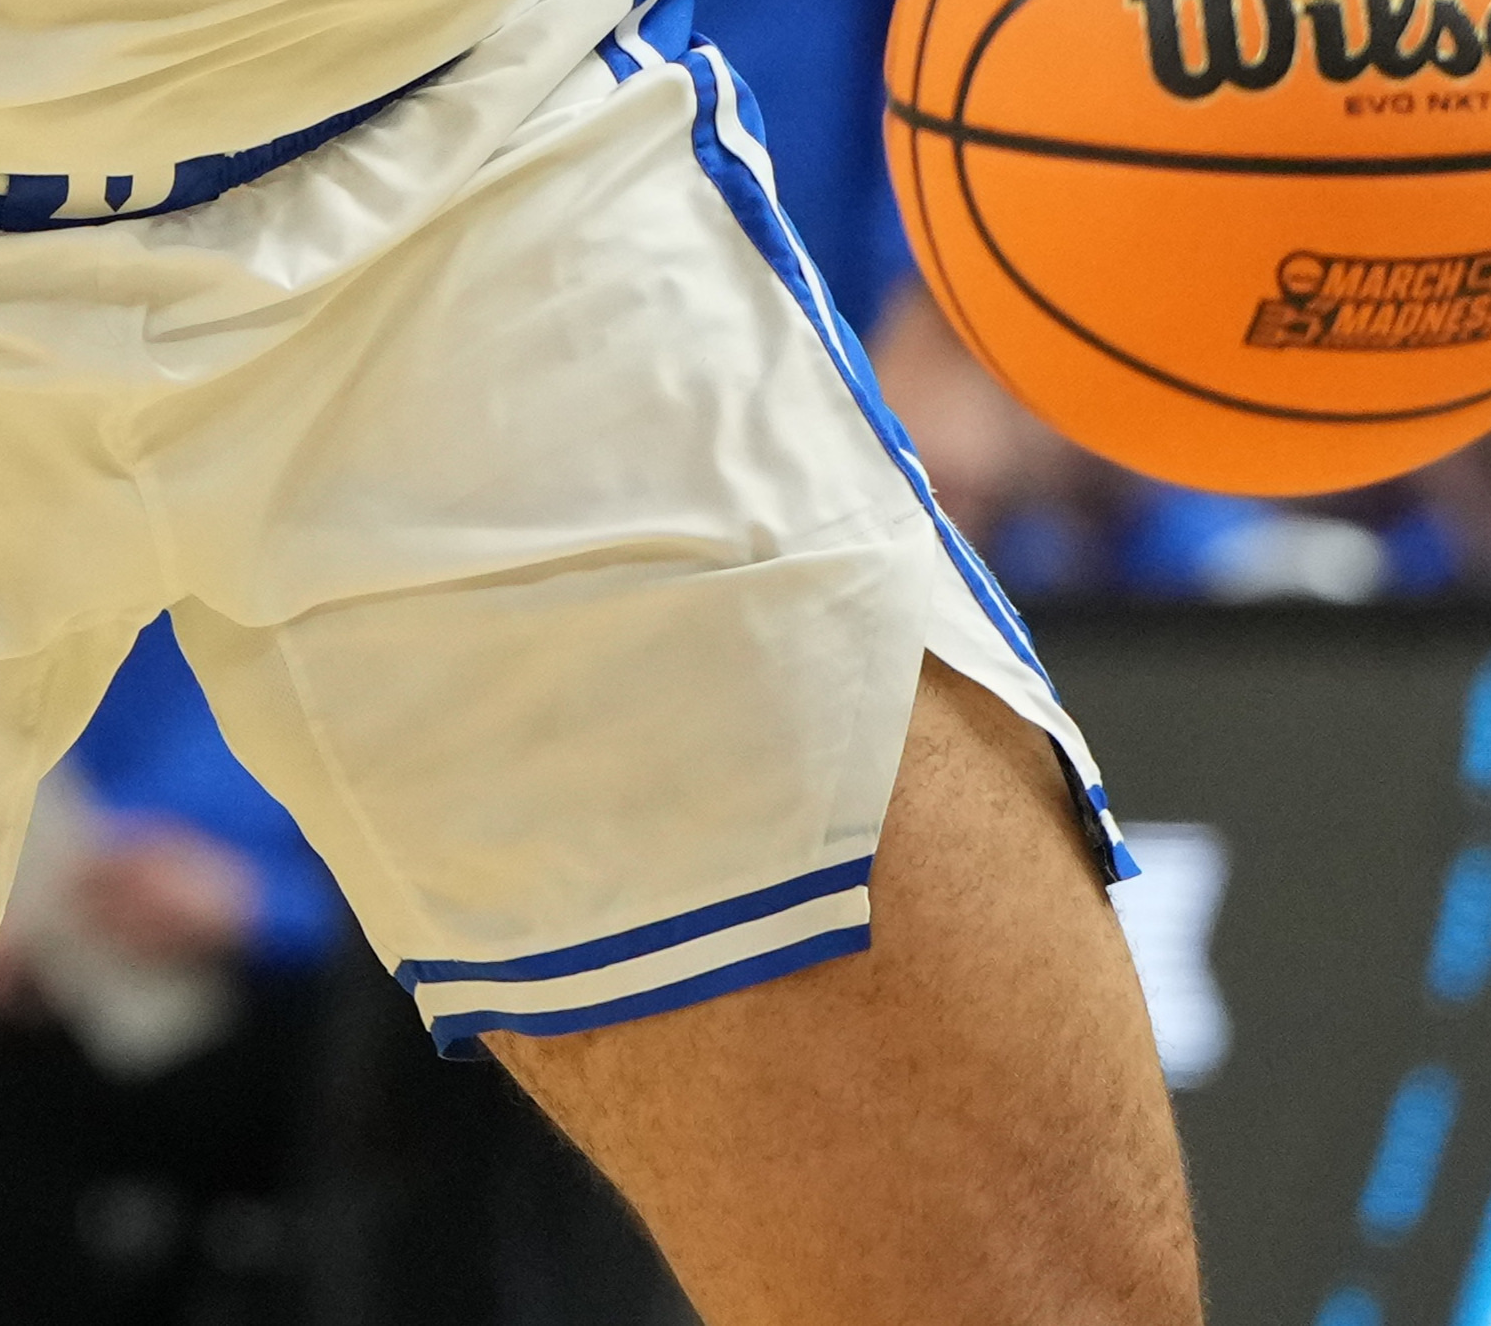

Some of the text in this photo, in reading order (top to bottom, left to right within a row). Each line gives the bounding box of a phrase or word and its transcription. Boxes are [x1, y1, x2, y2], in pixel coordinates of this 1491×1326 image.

[1343, 90, 1491, 117] EVO NXT
[1322, 259, 1467, 299] MARCH
